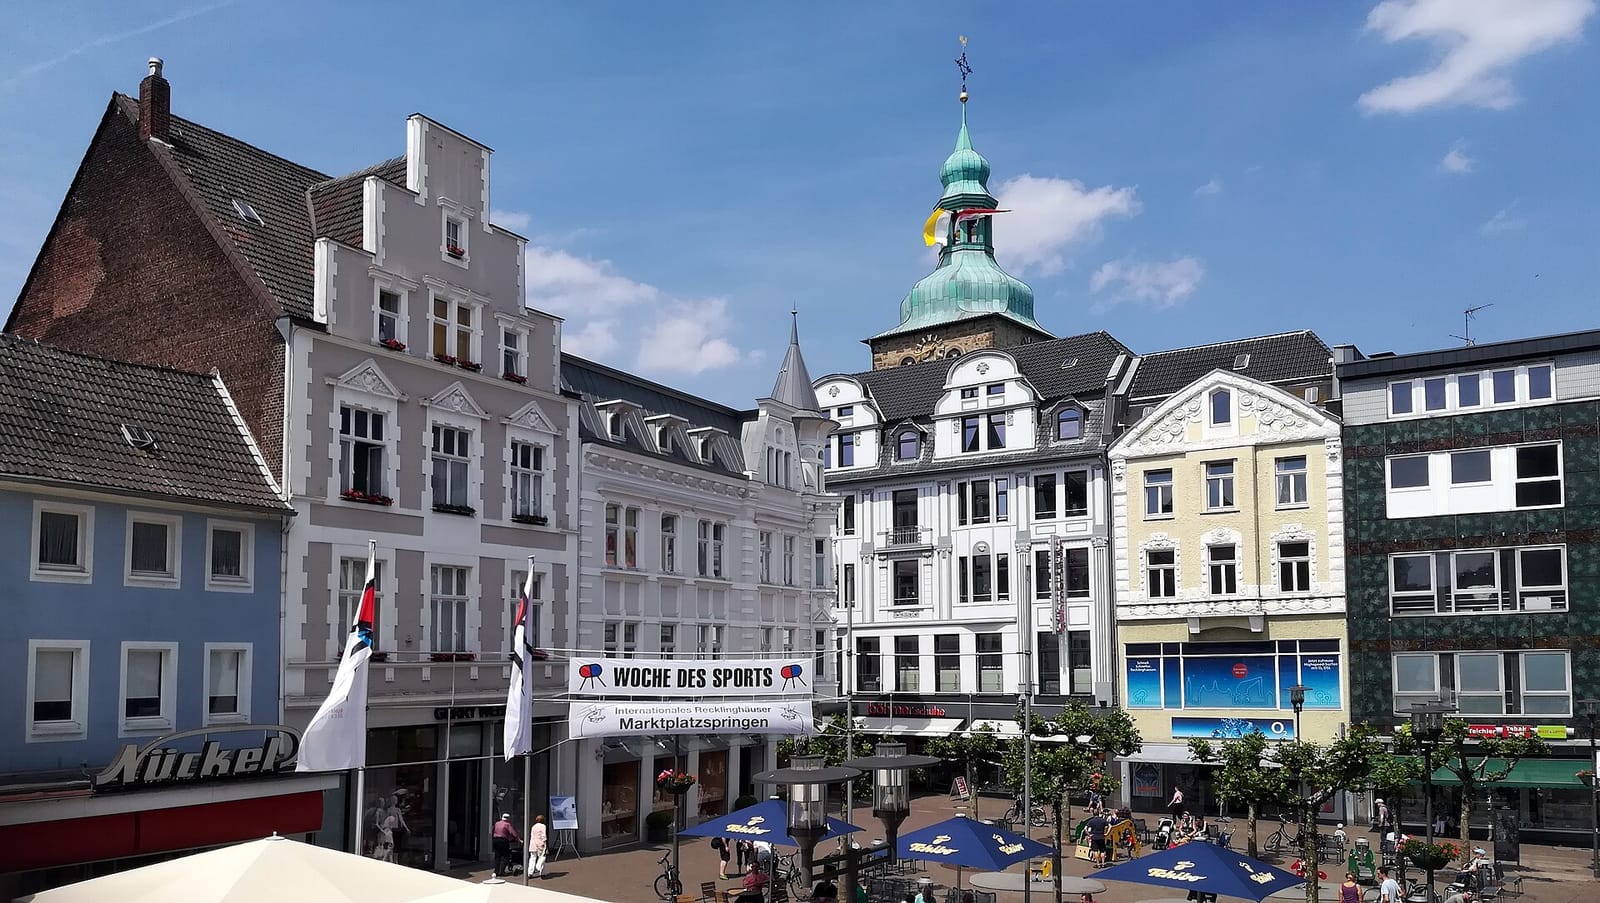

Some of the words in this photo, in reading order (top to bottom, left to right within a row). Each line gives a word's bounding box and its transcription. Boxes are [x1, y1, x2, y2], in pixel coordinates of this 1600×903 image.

[614, 667, 671, 688] WOCHE
[677, 668, 707, 688] DES
[712, 667, 773, 688] SPORTS
[615, 706, 692, 715] Internationales
[694, 705, 772, 716] Recklinghäuser
[619, 716, 769, 731] Marktplatzspringen
[96, 737, 282, 786] Nückel
[1148, 868, 1207, 882] Tchibo
